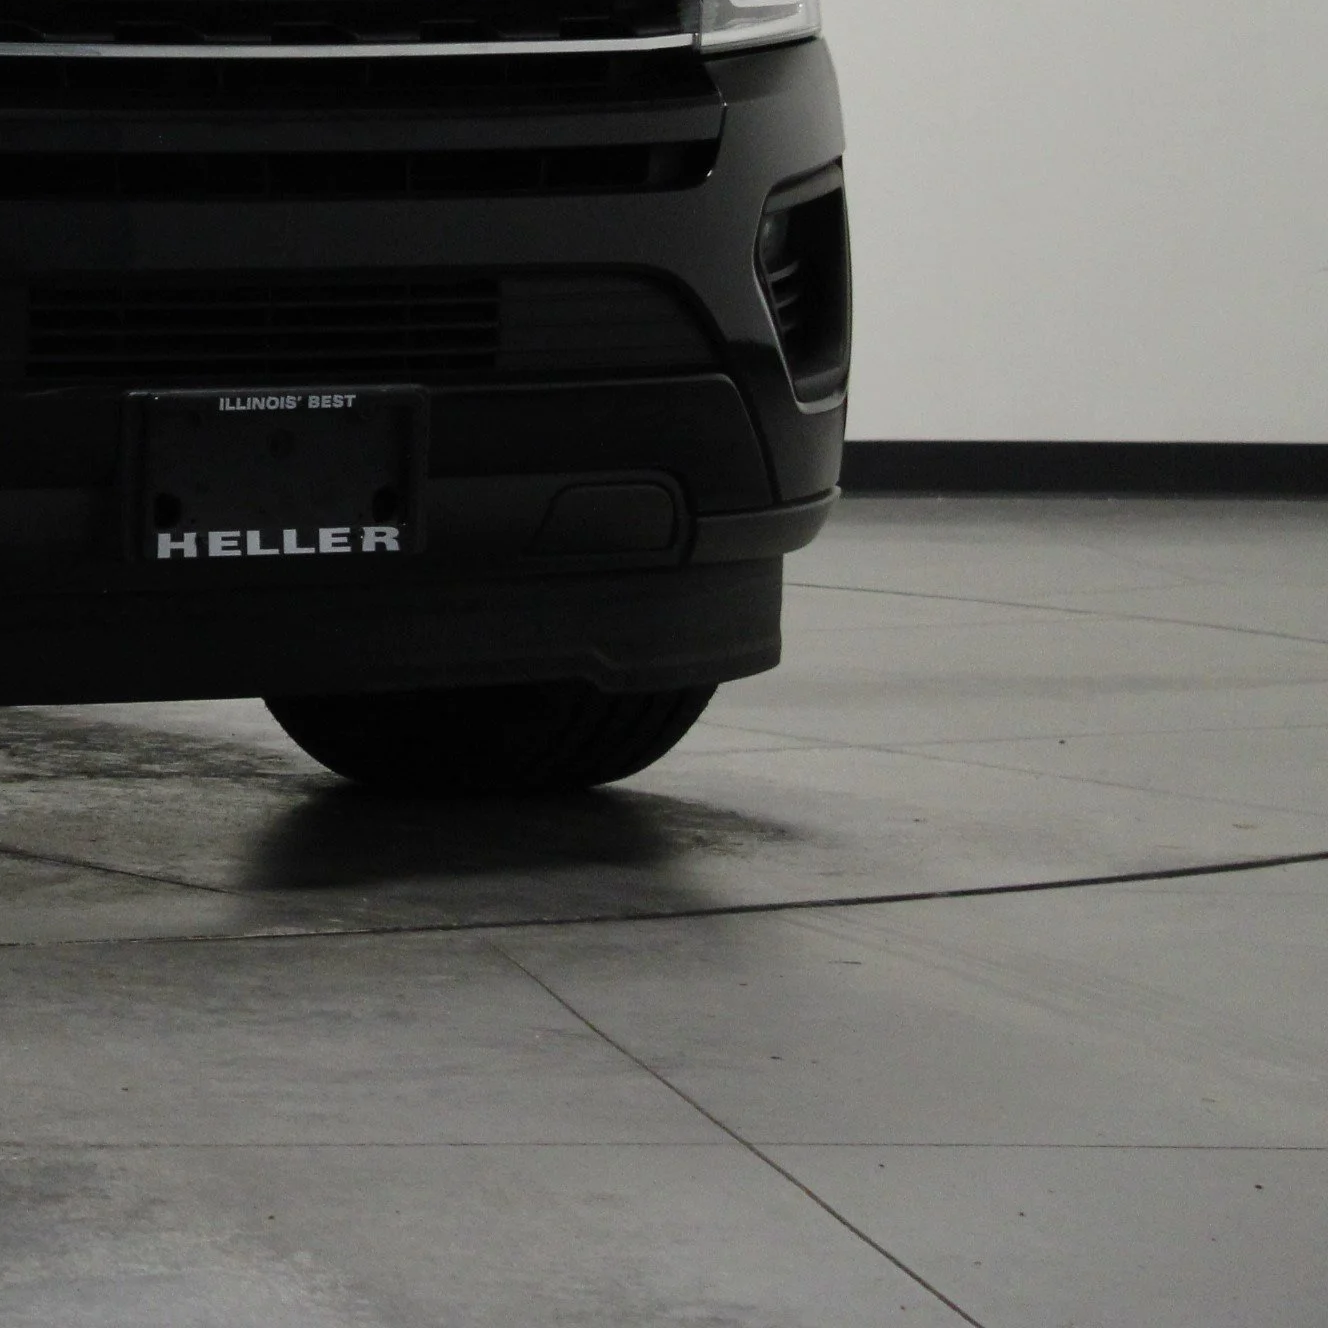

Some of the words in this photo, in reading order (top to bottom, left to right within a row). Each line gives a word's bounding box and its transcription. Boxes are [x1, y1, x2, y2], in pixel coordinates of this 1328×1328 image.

[218, 395, 302, 411] ILLINOIS'
[307, 394, 357, 409] BEST
[156, 525, 401, 560] HELLER
